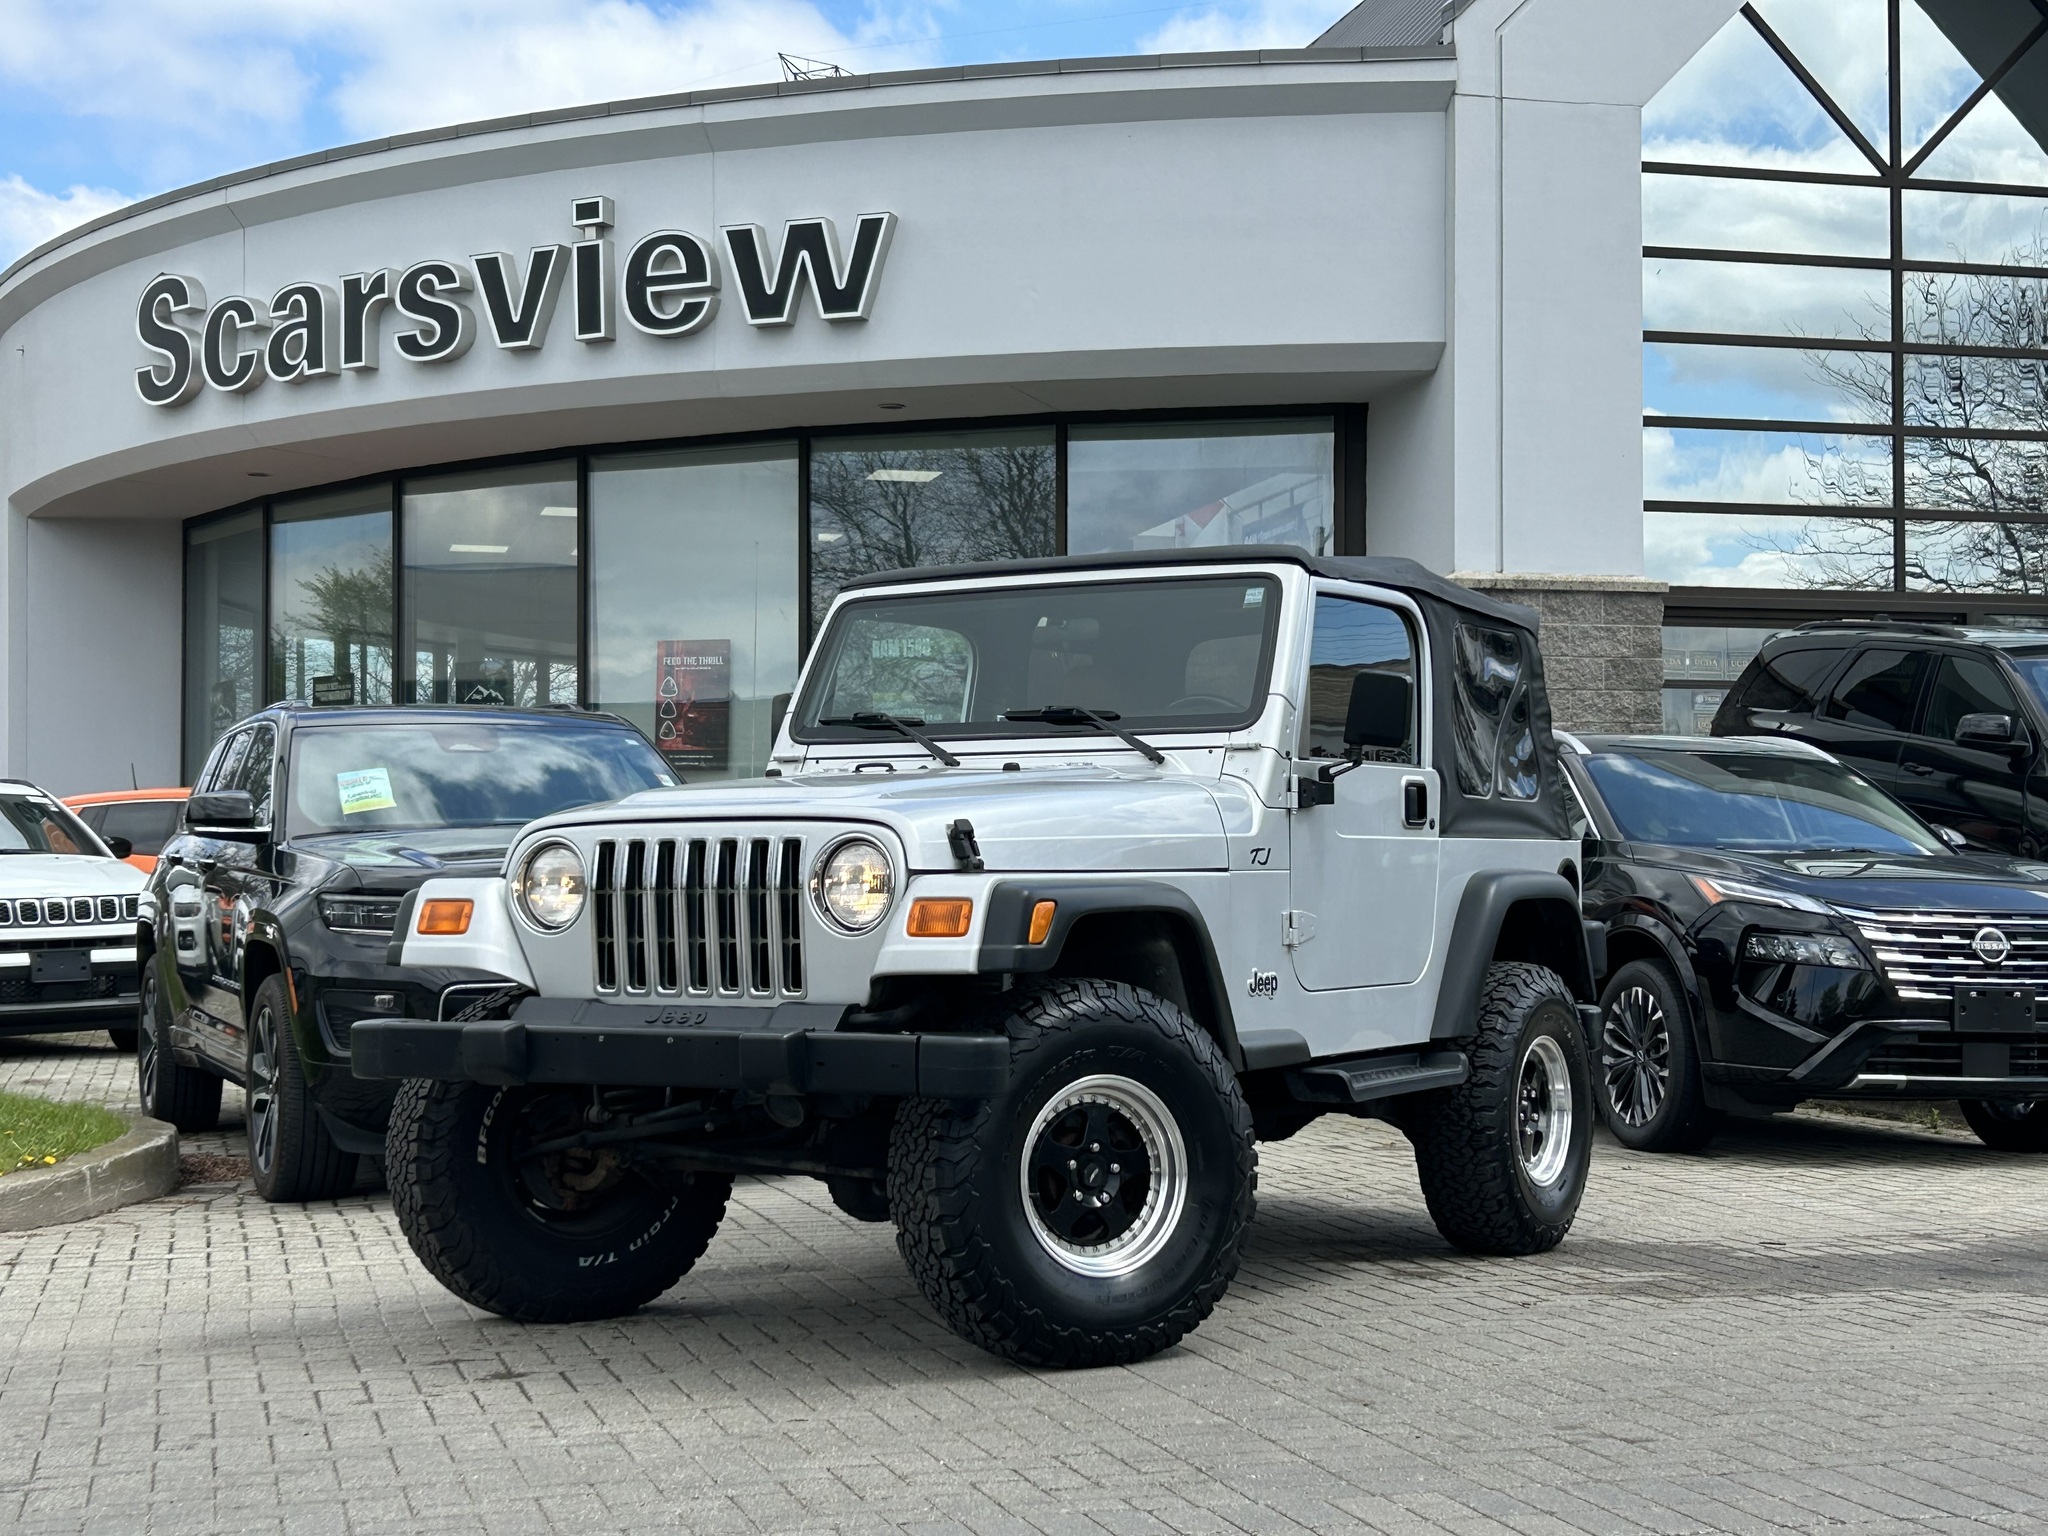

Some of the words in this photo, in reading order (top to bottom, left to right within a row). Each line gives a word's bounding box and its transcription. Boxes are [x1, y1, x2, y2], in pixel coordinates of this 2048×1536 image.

[134, 195, 897, 408] Scarsview
[663, 656, 681, 666] FEED
[683, 656, 697, 665] THE
[698, 655, 724, 665] THRILL
[1694, 659, 1718, 667] UCDA
[1250, 848, 1271, 865] TJ
[1971, 940, 2011, 950] NISSAN
[1248, 968, 1278, 1000] Jeep
[644, 1005, 708, 1027] Jeep
